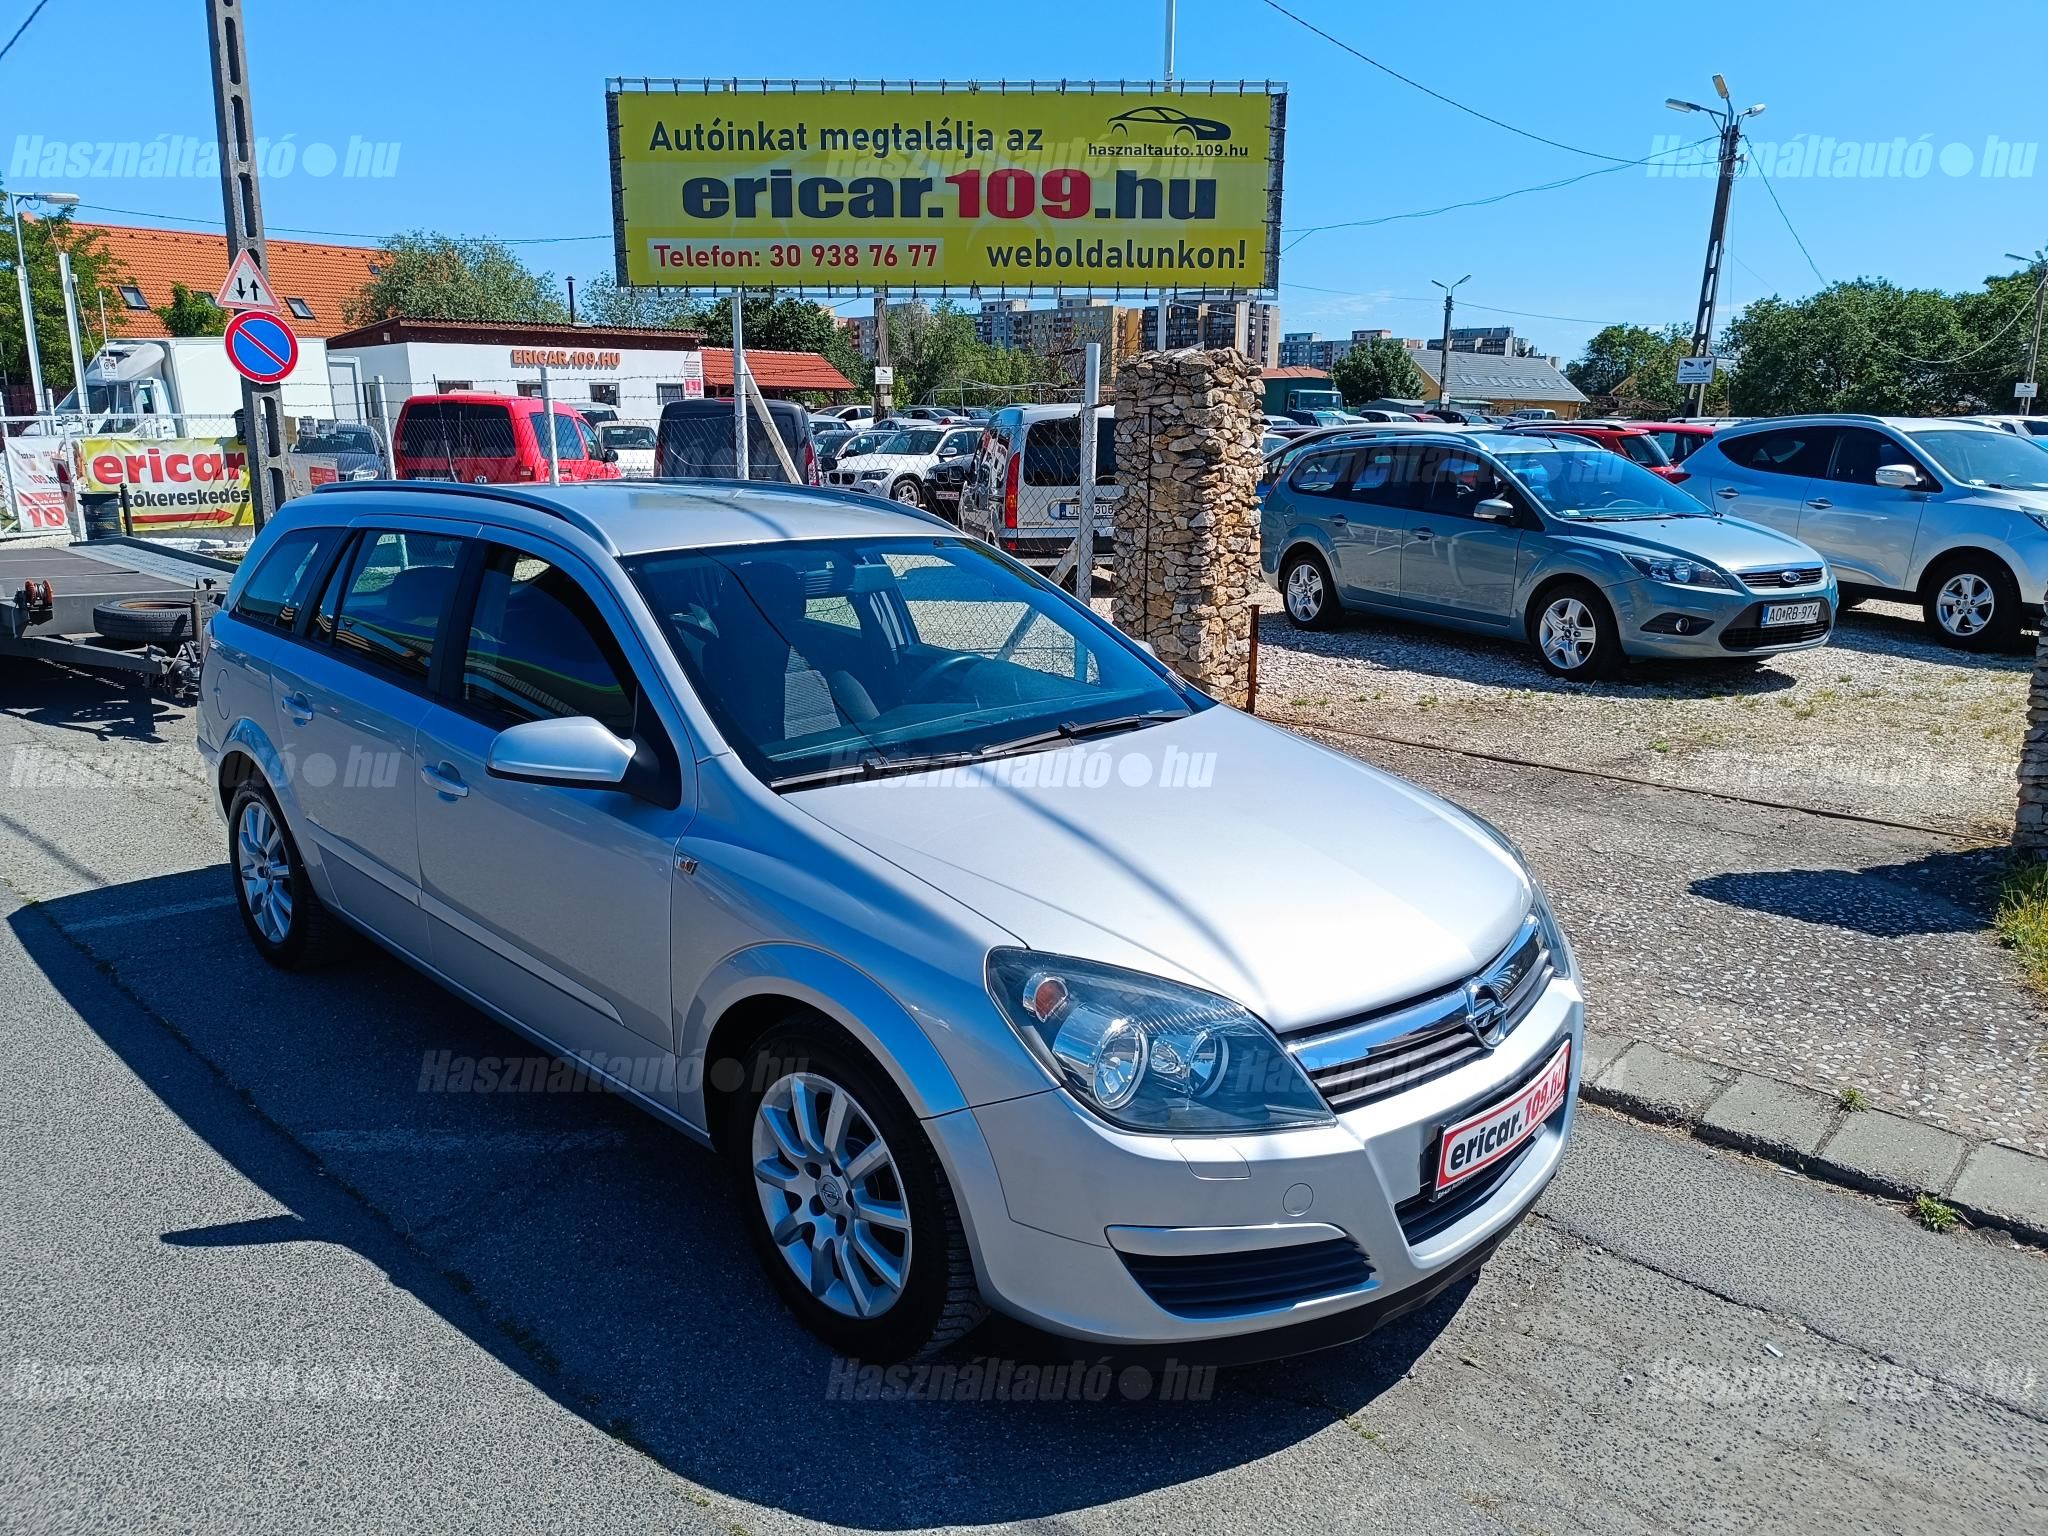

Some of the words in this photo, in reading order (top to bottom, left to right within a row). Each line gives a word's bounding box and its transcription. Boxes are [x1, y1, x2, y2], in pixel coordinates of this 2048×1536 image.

[650, 116, 807, 150] Autóinkat
[820, 116, 994, 159] megtalálja
[1006, 128, 1043, 150] az
[1088, 142, 1249, 157] hasznaltauto.109.hu
[683, 168, 1217, 219] ericar.109.hu
[653, 244, 760, 267] Telefon:
[769, 244, 801, 267] 30
[811, 244, 859, 267] 938
[869, 244, 898, 267] 76
[908, 244, 938, 267] 77
[986, 238, 1247, 270] weboldalunkon!
[510, 349, 621, 368] ERICAR.109.HU
[92, 448, 246, 486] ericar
[120, 487, 250, 508] tókereskedés
